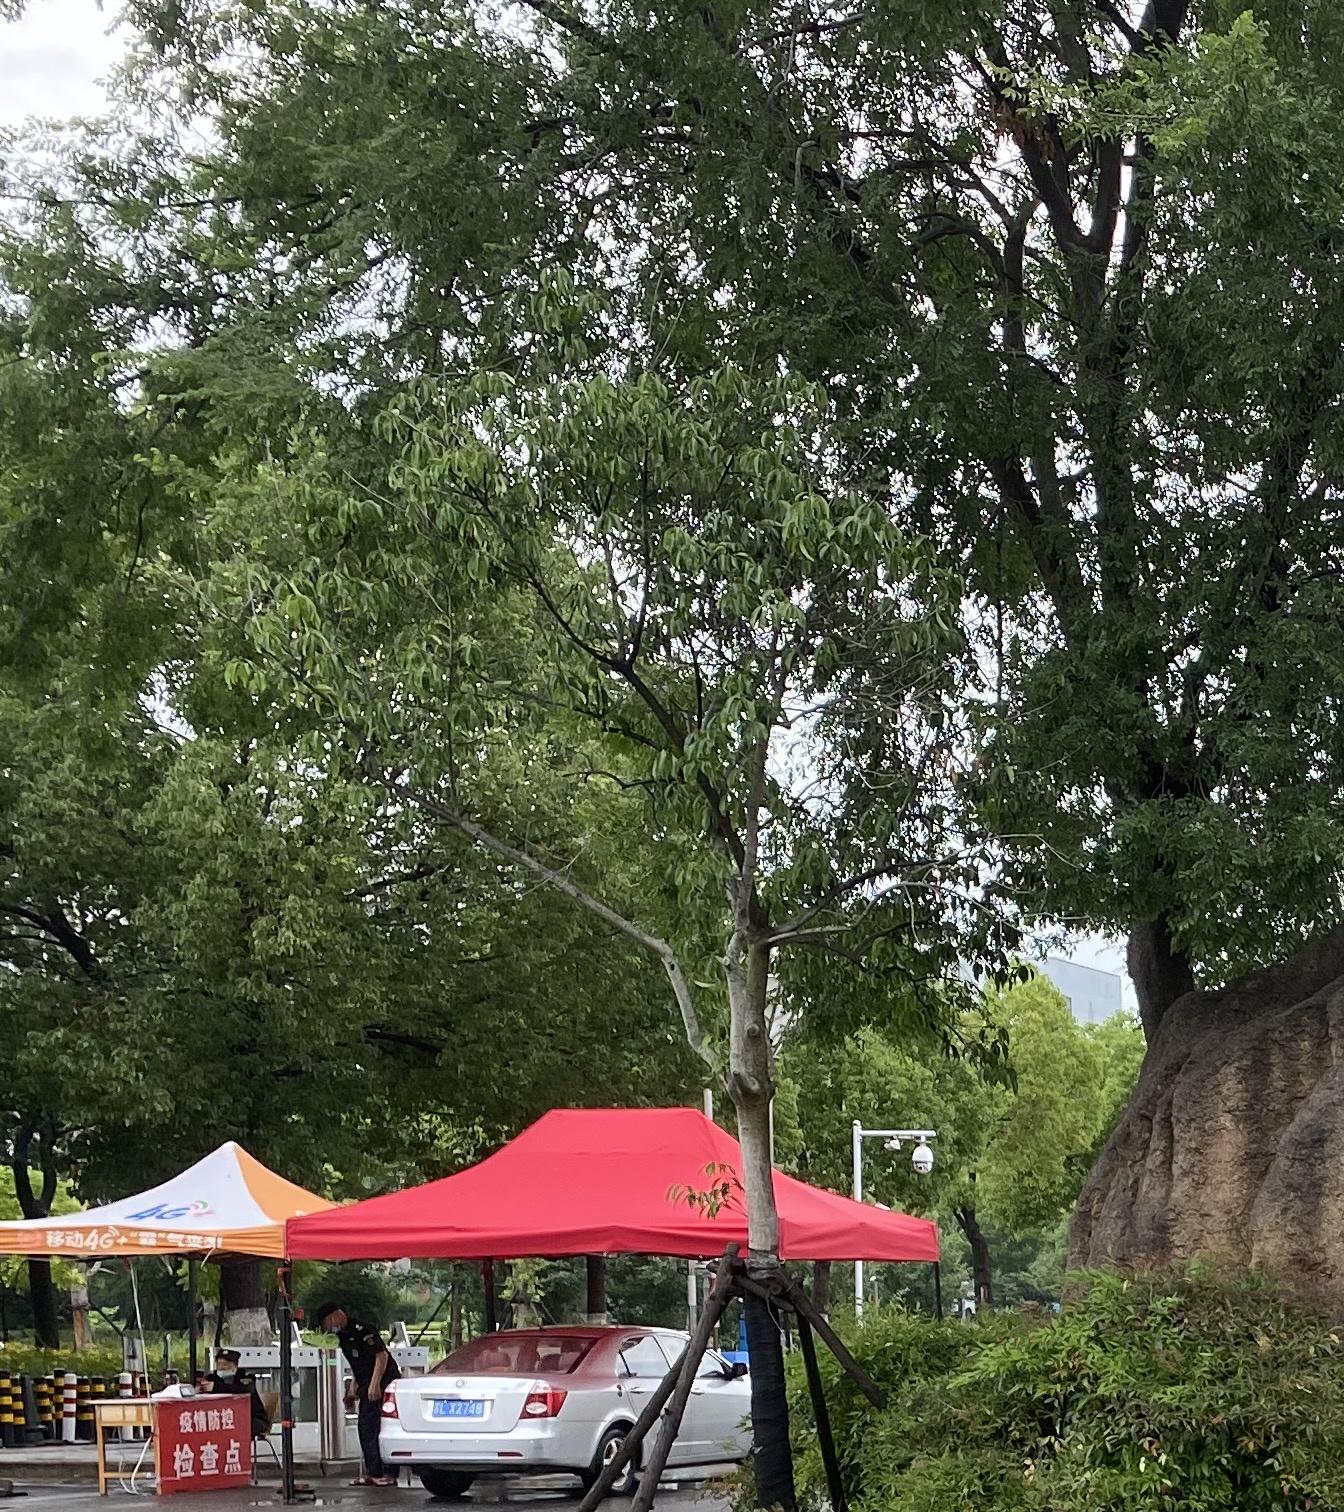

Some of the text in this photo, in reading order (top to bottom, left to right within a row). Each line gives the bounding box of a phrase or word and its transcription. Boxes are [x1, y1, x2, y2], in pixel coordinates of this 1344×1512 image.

[124, 1203, 190, 1221] 4G
[179, 1408, 236, 1433] 疫情防控
[173, 1439, 242, 1480] 检查点
